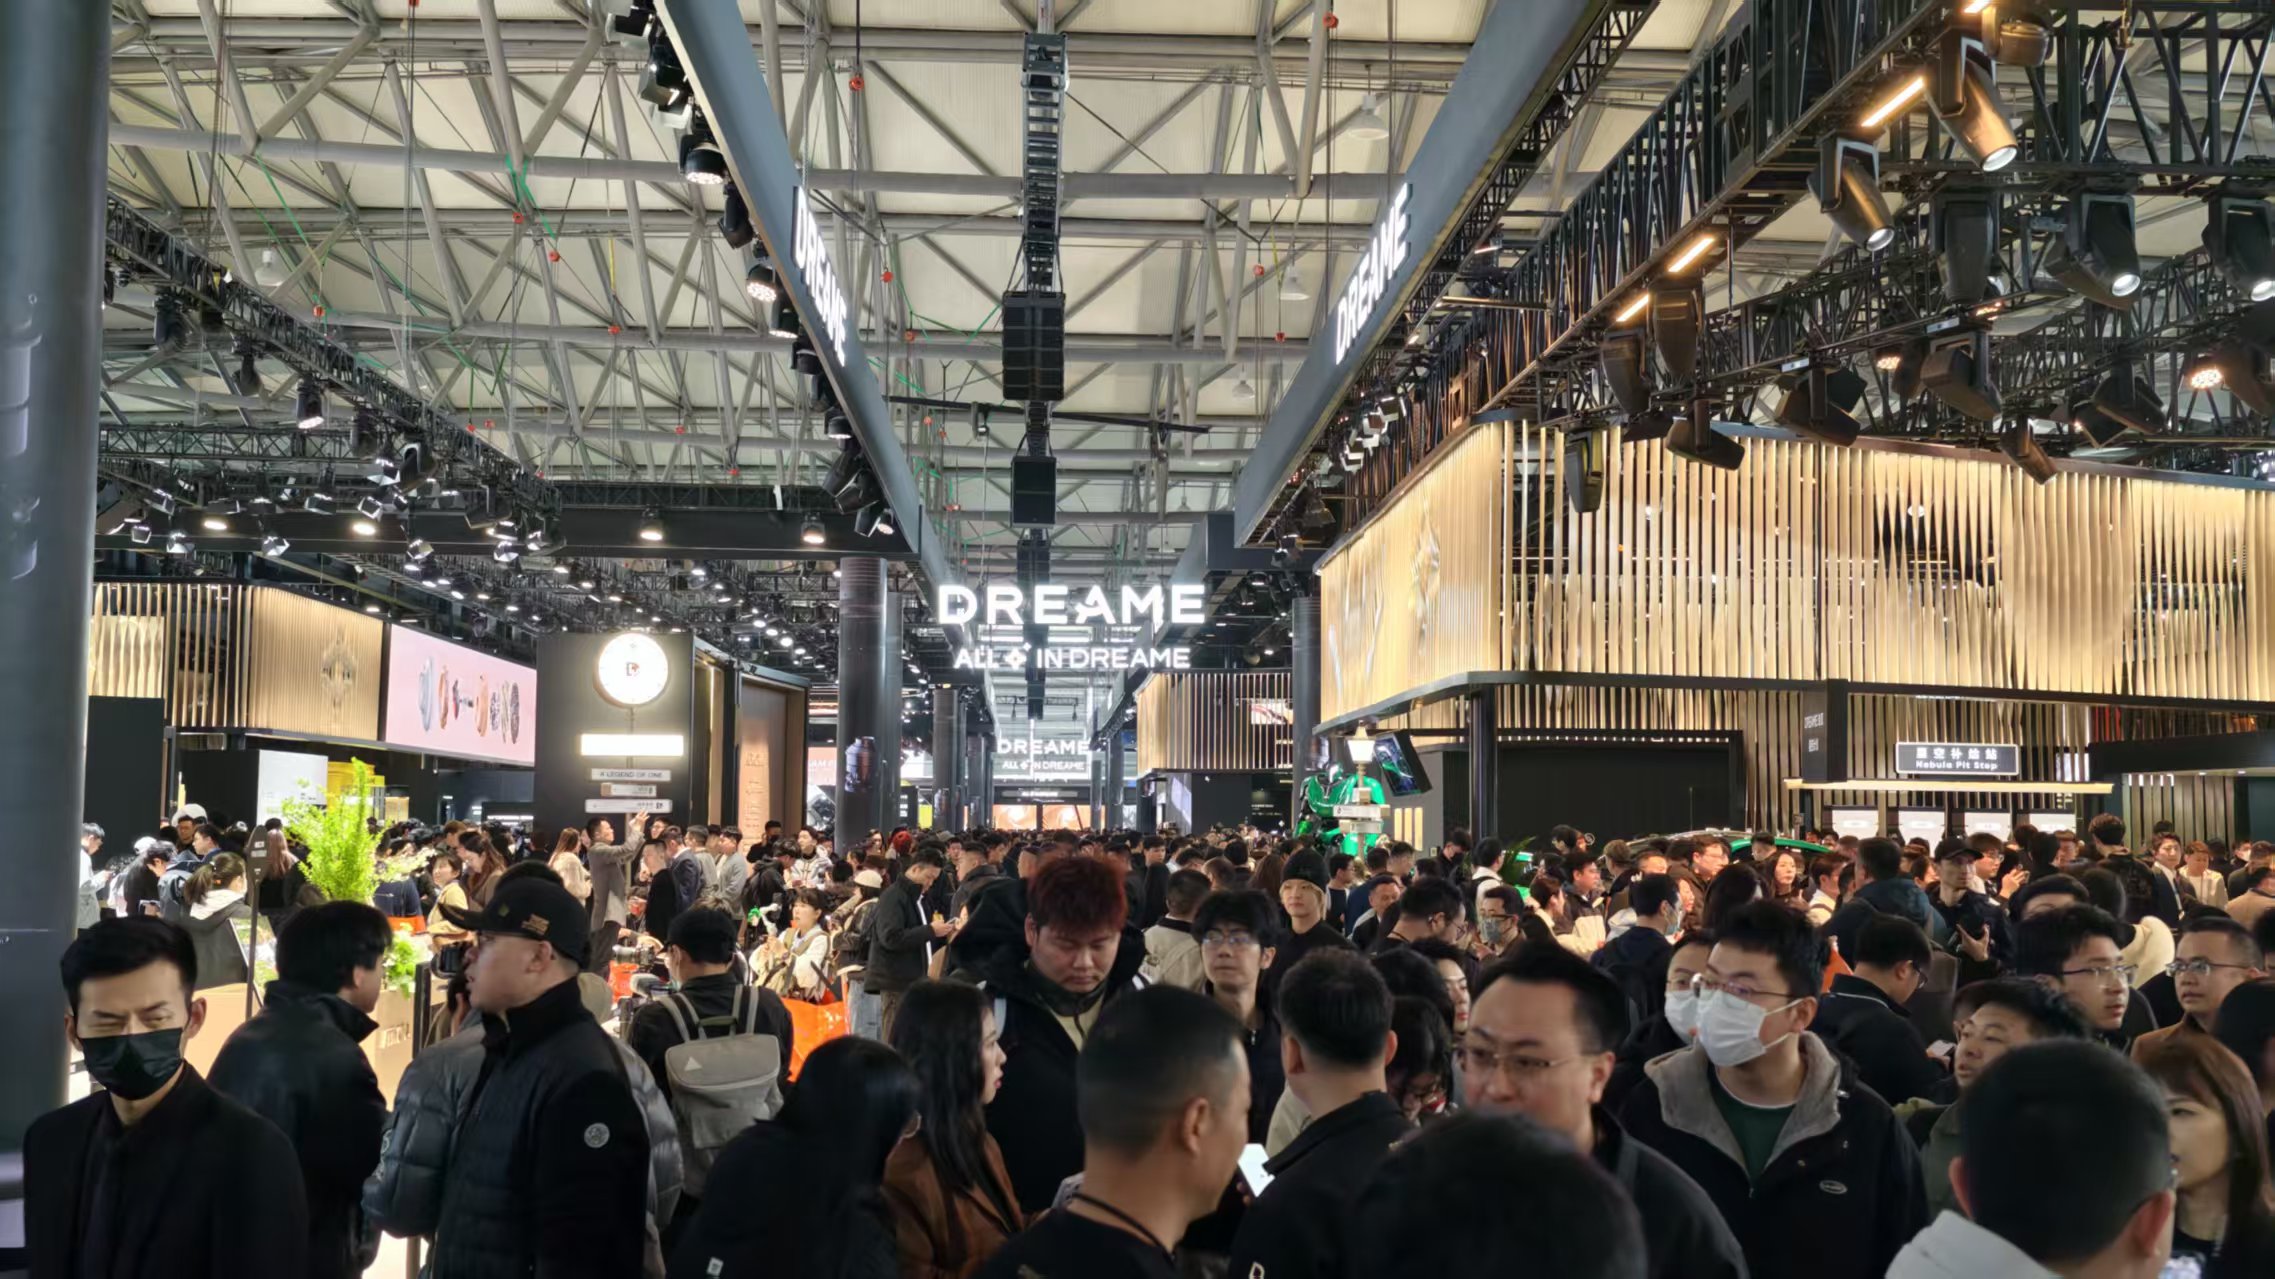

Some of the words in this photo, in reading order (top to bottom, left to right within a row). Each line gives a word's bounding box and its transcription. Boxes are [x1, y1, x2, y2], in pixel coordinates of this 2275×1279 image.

[795, 185, 847, 367] DREAME
[1335, 182, 1408, 365] DREAME
[938, 584, 1206, 625] DREAME
[954, 648, 1000, 668] ALL
[997, 738, 1090, 755] DREAME
[1915, 760, 1953, 769] Nebula
[1956, 761, 1971, 770] Pit
[1974, 761, 1998, 772] Stop
